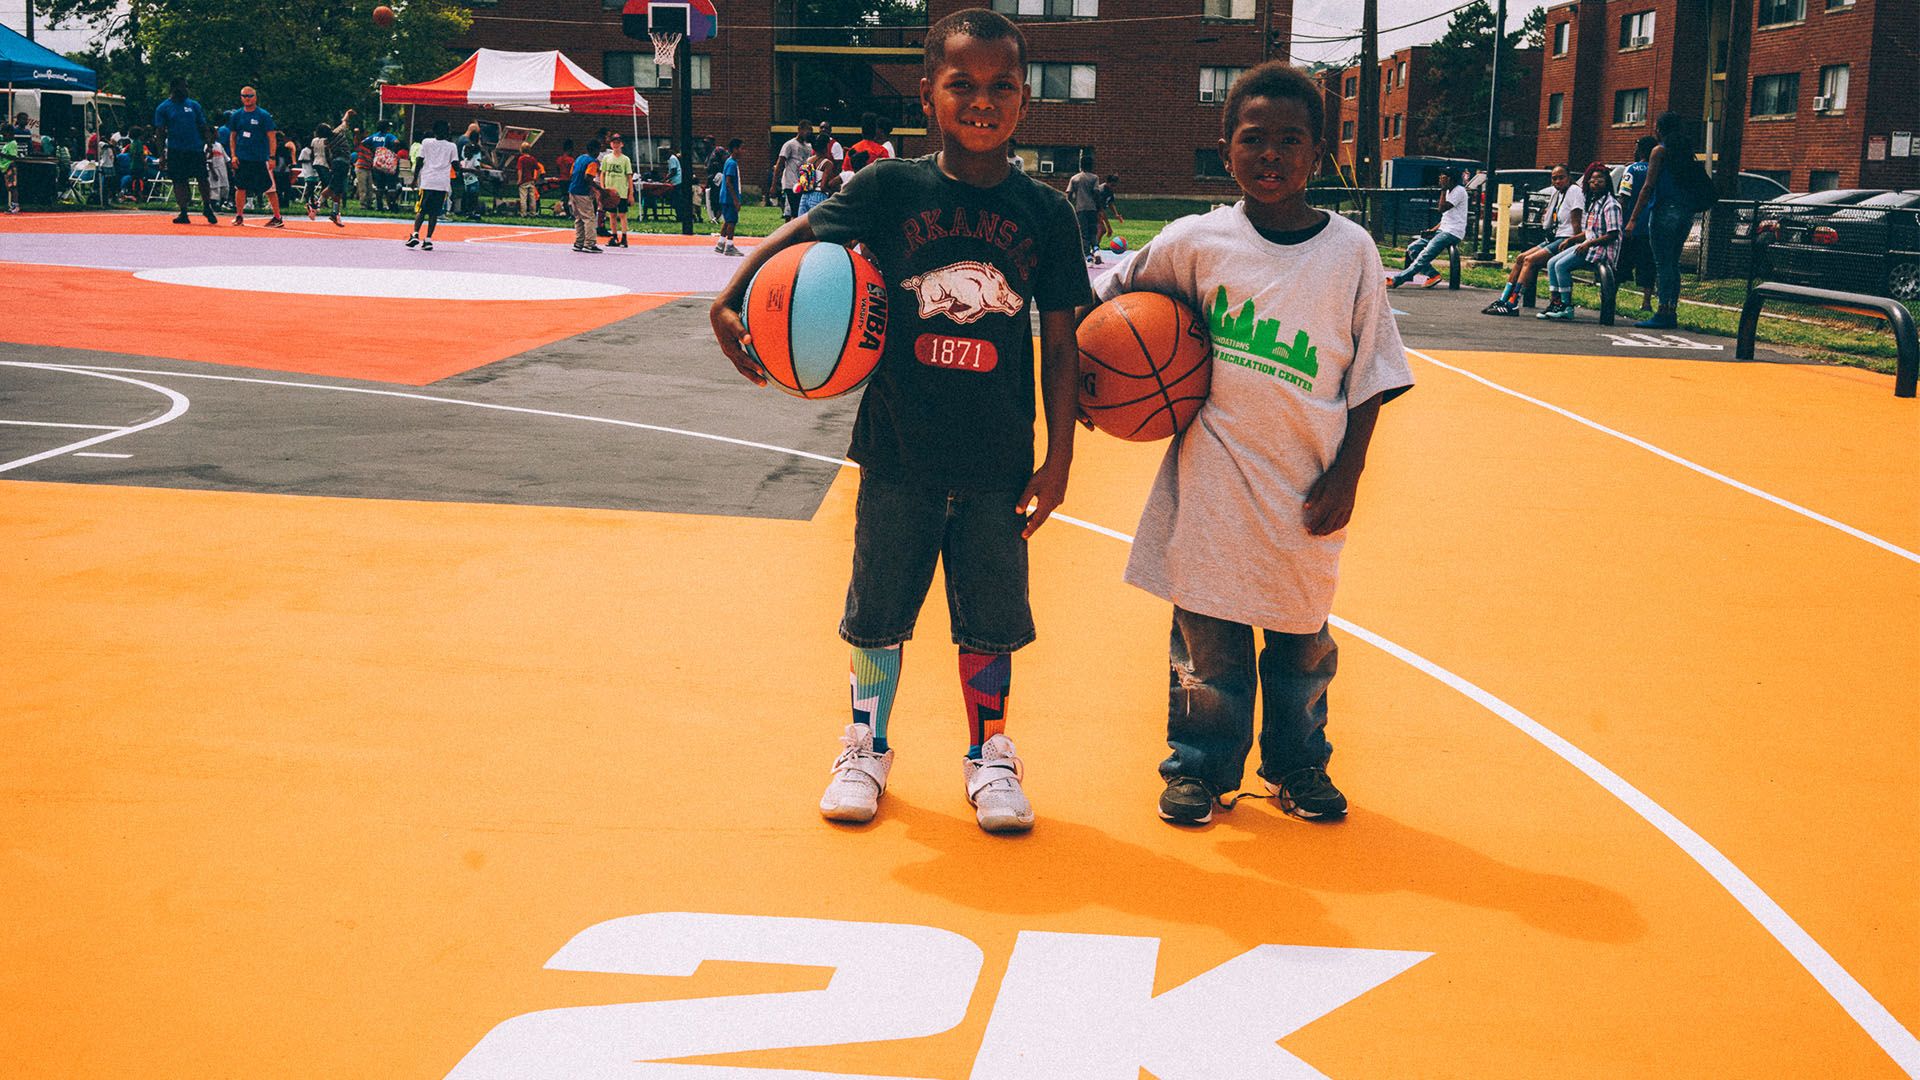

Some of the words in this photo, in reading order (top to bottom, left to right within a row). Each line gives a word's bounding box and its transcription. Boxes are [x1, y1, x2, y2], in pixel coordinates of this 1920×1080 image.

[858, 298, 867, 330] VARSITY
[858, 296, 886, 350] NBA
[930, 338, 982, 368] 1871
[1219, 351, 1277, 377] RECREATION
[1278, 369, 1313, 393] CENTER
[441, 911, 1438, 1080] 2K
